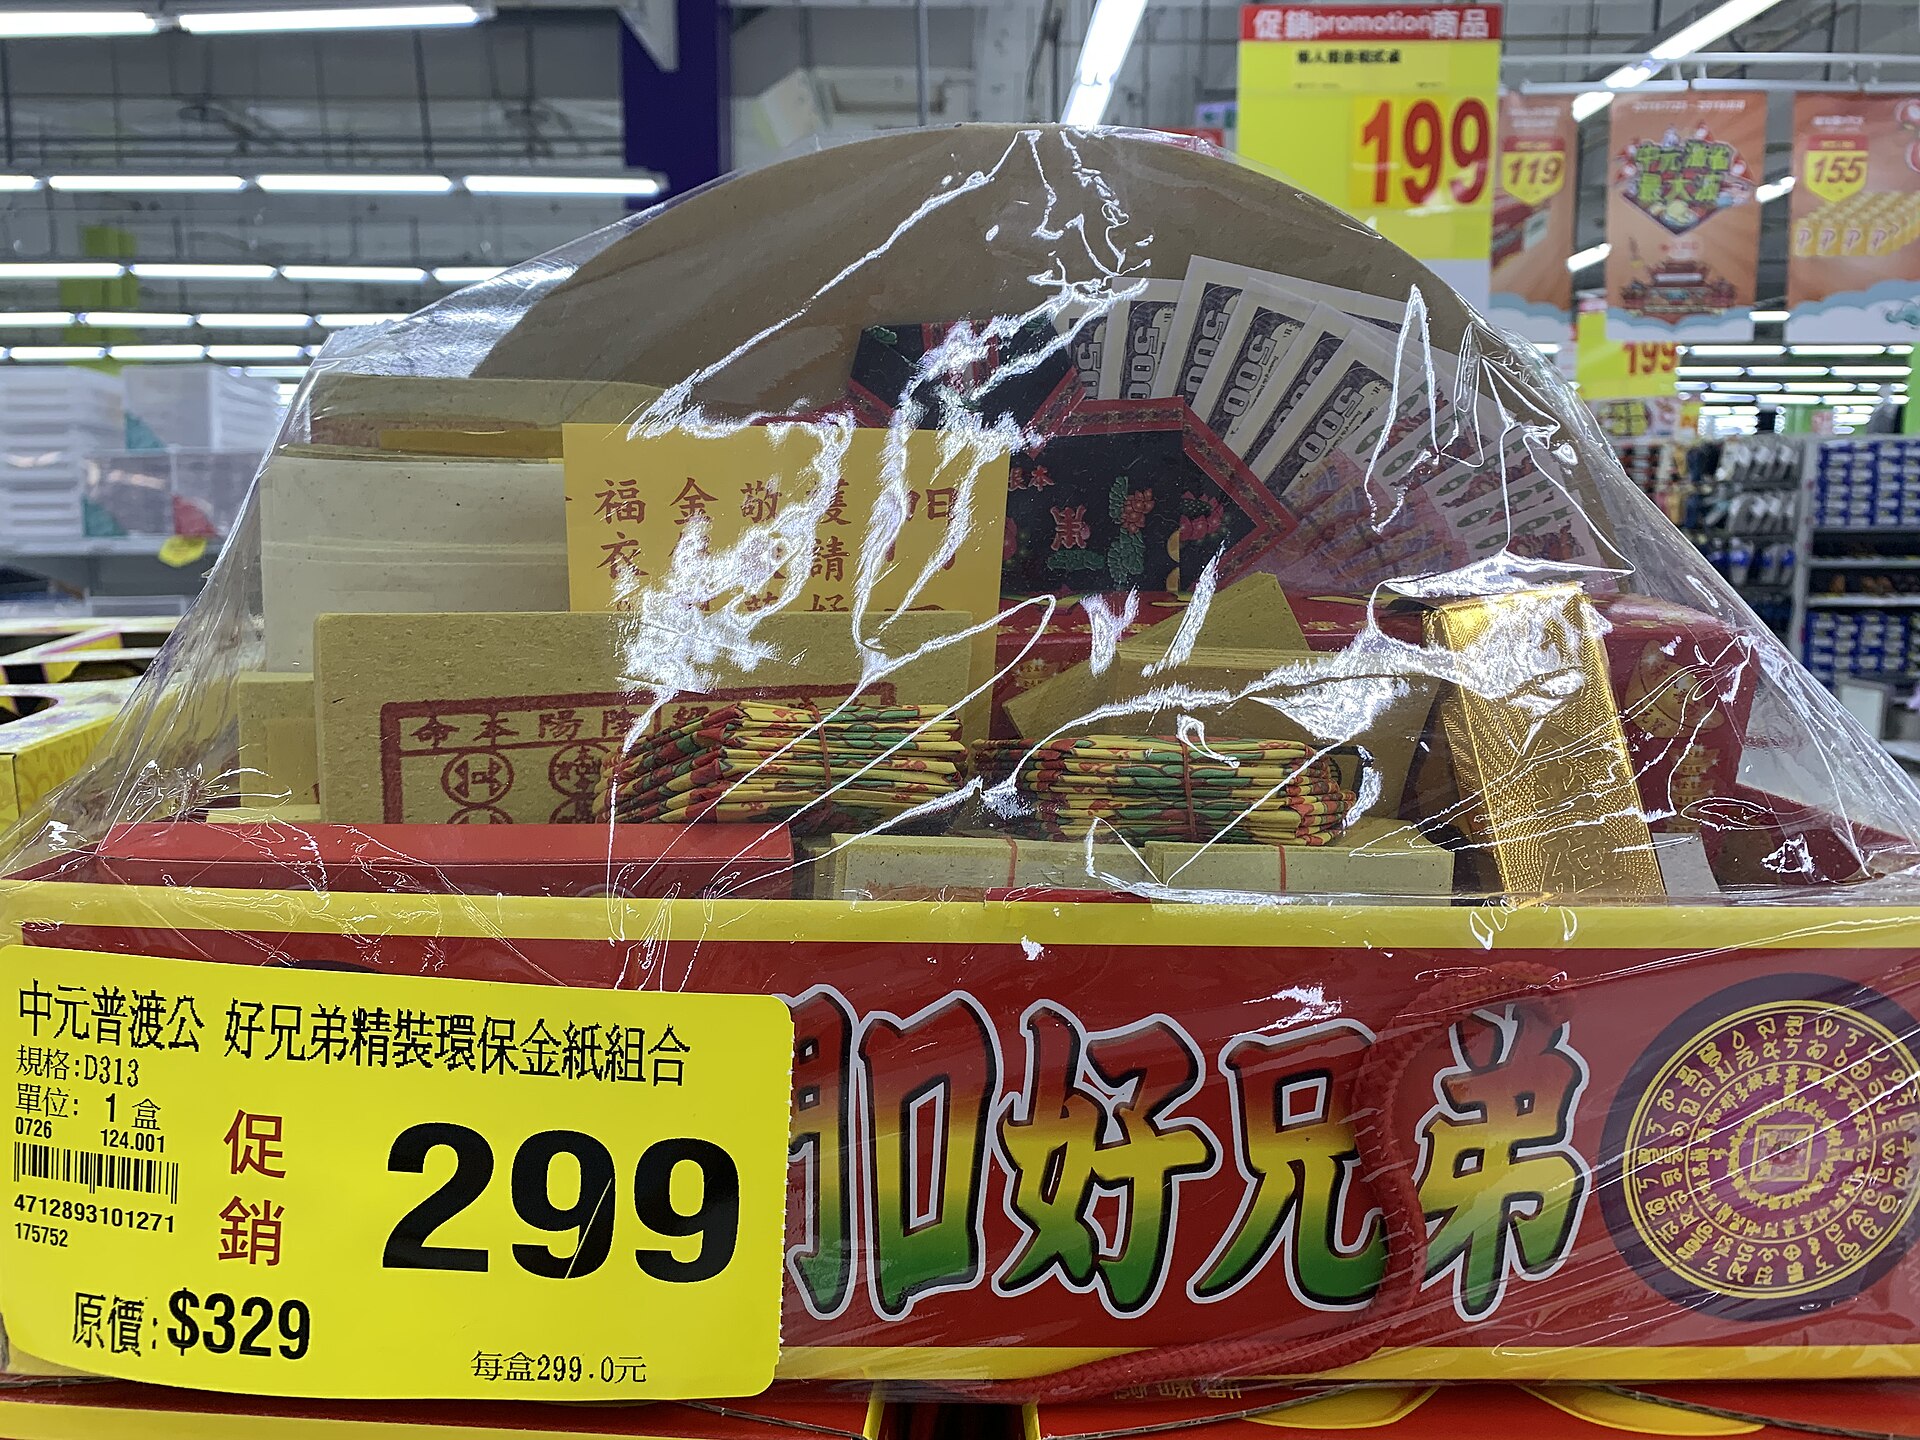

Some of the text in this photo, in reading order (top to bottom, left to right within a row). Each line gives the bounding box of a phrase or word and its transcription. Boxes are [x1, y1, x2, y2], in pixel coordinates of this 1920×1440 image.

[1362, 98, 1490, 204] 199
[1508, 156, 1563, 186] 119
[1813, 155, 1869, 184] 155
[1223, 333, 1278, 418] 500
[1298, 386, 1365, 463] 500
[18, 978, 692, 1087] 中元普渡公 好兄弟精裝環保金紙組合
[15, 1044, 139, 1087] 規格:D313
[15, 1082, 162, 1131] 單位: 1 盒
[15, 1117, 165, 1153] 0726 124.001
[217, 1108, 287, 1267] 促銷
[382, 1122, 741, 1284] 299
[14, 1194, 175, 1233] 4712893101271
[14, 1223, 68, 1247] 175752
[470, 1350, 648, 1384] 每盒299.0元
